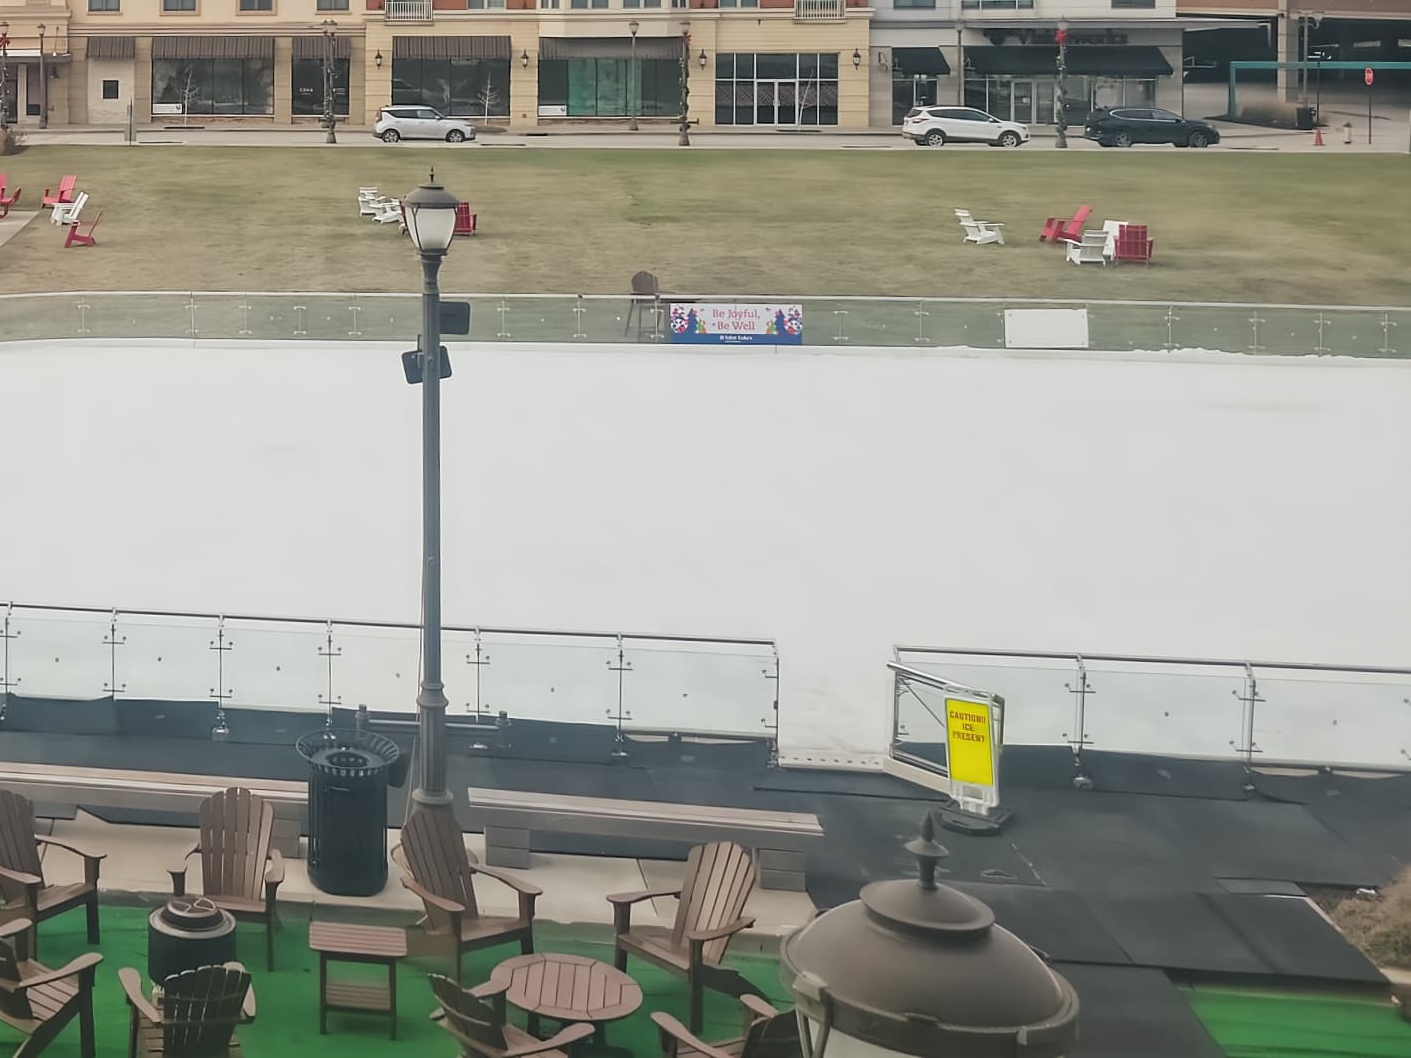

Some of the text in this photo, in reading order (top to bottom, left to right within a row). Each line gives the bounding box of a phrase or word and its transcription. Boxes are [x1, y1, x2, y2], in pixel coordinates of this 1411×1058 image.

[712, 309, 761, 320] Be Joyful,
[717, 322, 755, 331] Be Well
[962, 722, 974, 732] ICE
